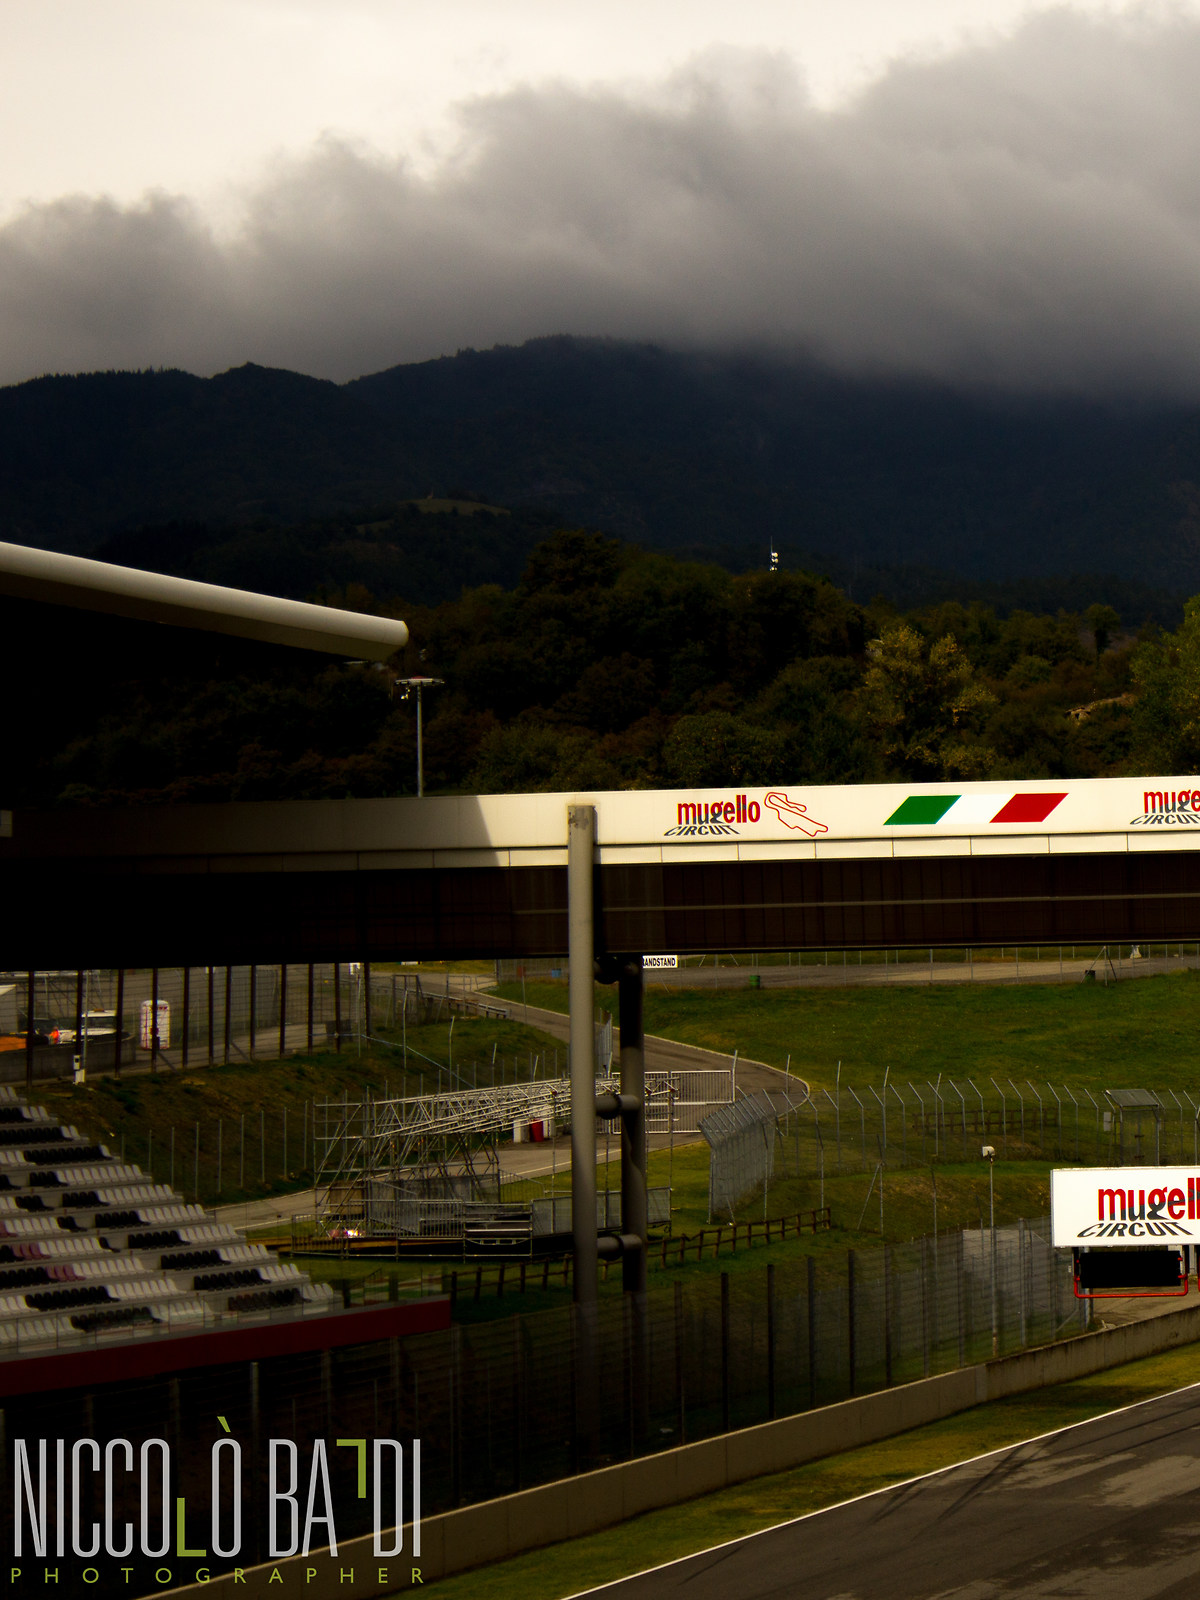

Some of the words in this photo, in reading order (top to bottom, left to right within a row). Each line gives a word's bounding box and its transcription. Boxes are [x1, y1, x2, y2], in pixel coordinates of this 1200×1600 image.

[677, 794, 761, 825] mugello
[664, 824, 740, 837] CIRCUIT
[1076, 1221, 1194, 1238] CIRCUIT
